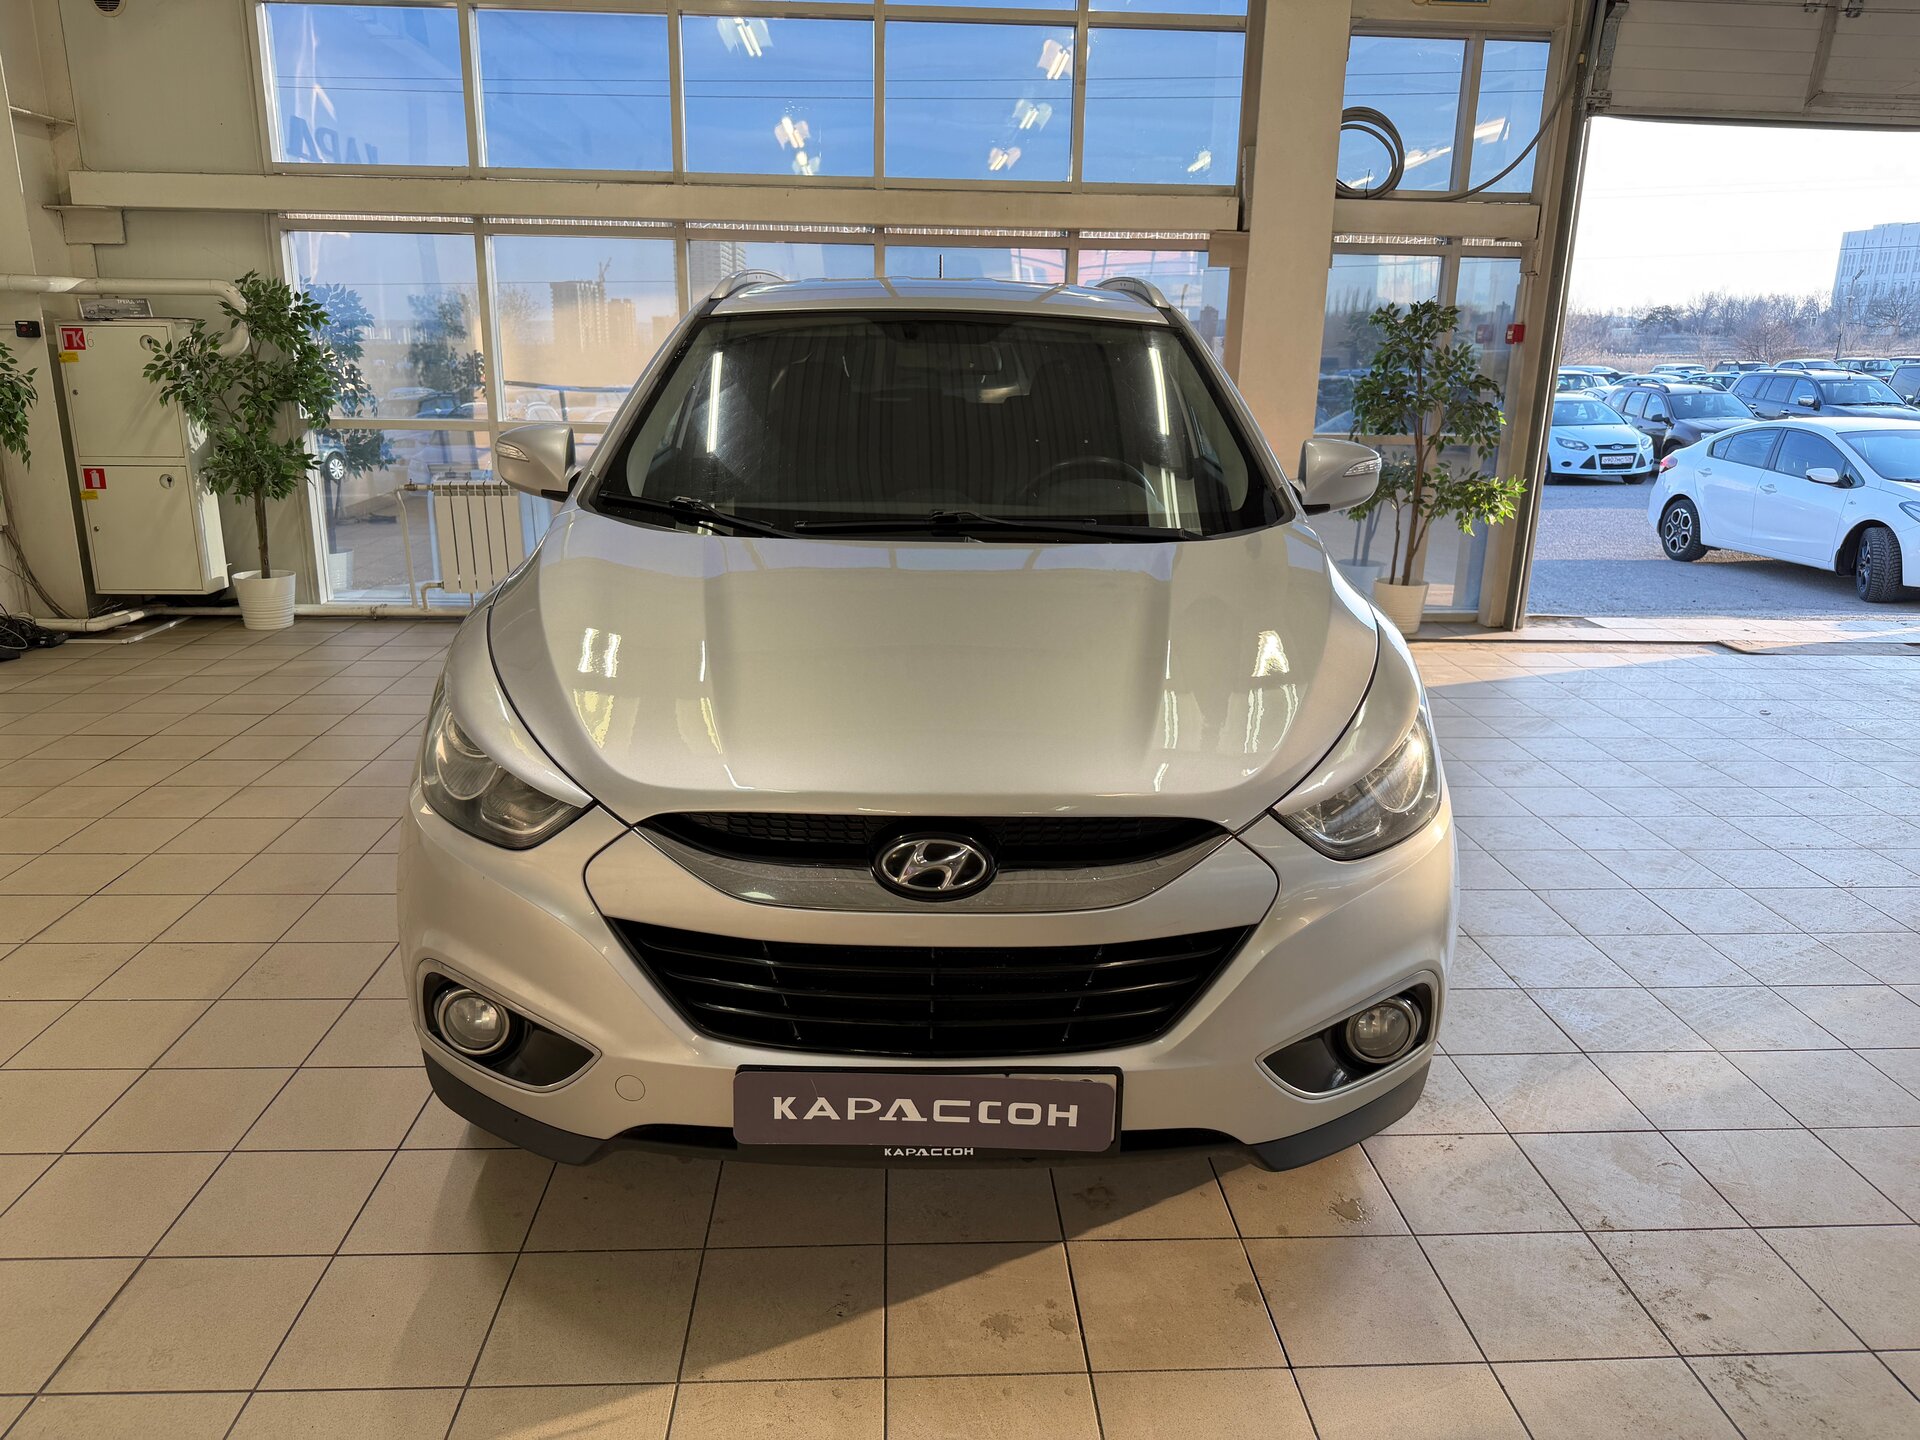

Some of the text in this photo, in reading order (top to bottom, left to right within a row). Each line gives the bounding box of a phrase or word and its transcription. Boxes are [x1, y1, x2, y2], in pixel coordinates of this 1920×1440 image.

[63, 330, 85, 348] ПК
[772, 1096, 1079, 1127] КАРАССОН
[884, 1147, 974, 1156] КАРАССОН
